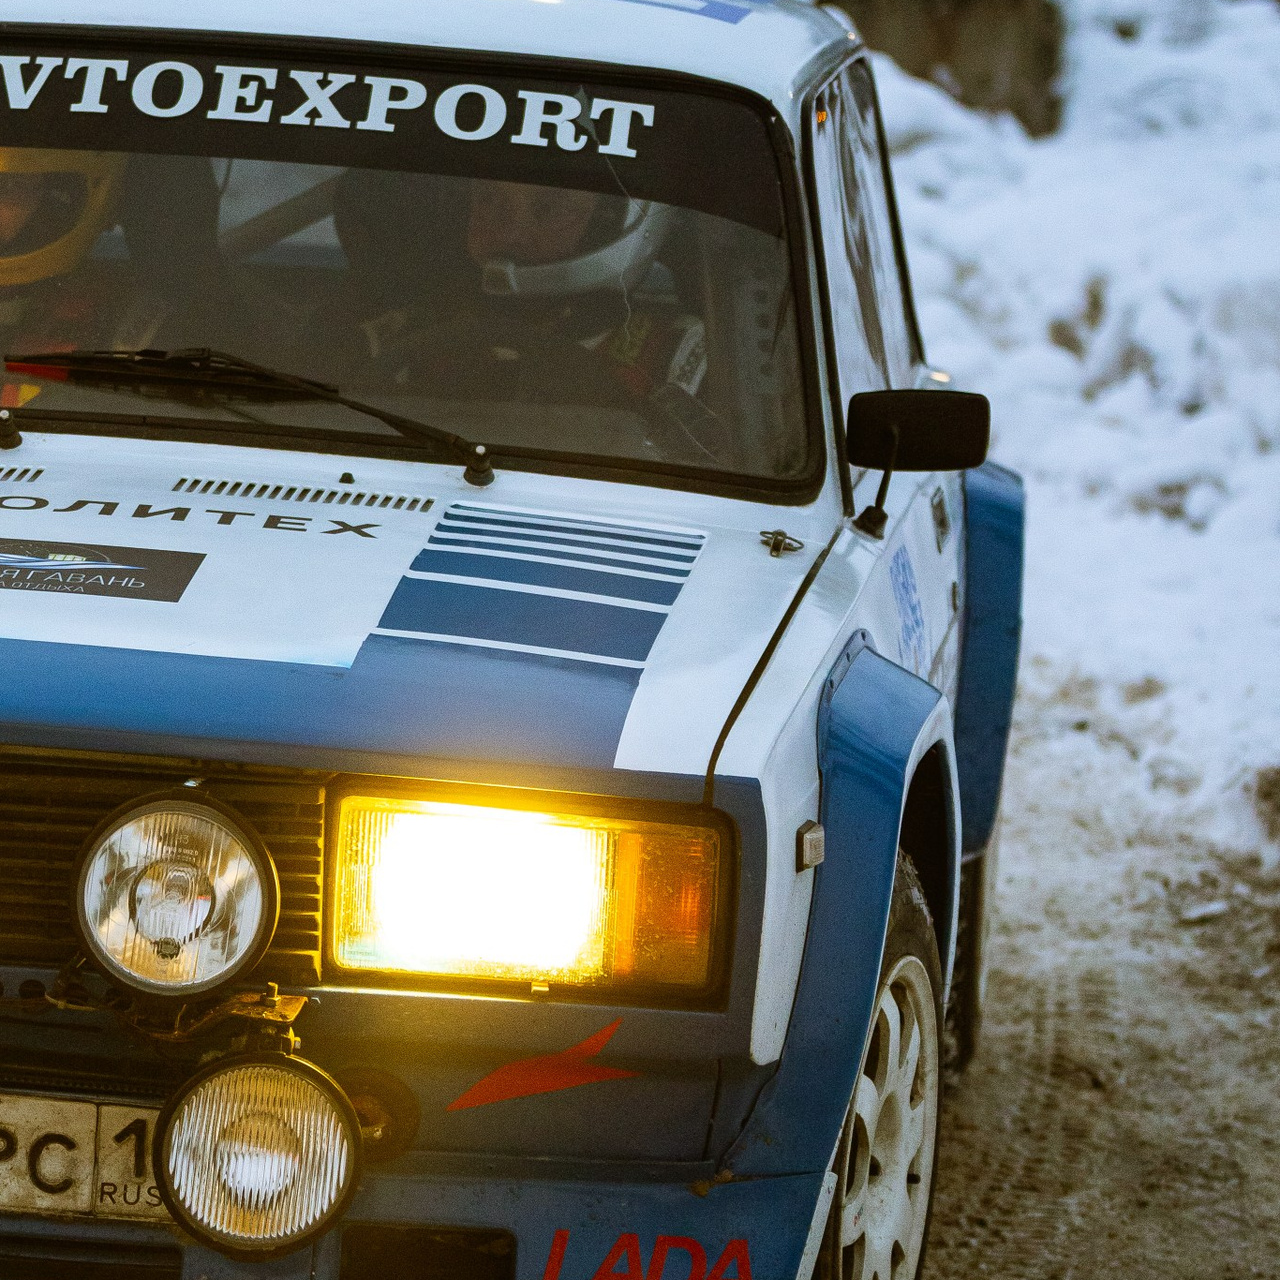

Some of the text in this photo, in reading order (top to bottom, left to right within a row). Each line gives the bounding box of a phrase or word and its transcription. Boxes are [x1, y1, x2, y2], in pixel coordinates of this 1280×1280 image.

[11, 580, 84, 593] ОТДЫХА
[26, 570, 146, 589] ГАВАНЬ
[100, 1182, 162, 1207] RUS
